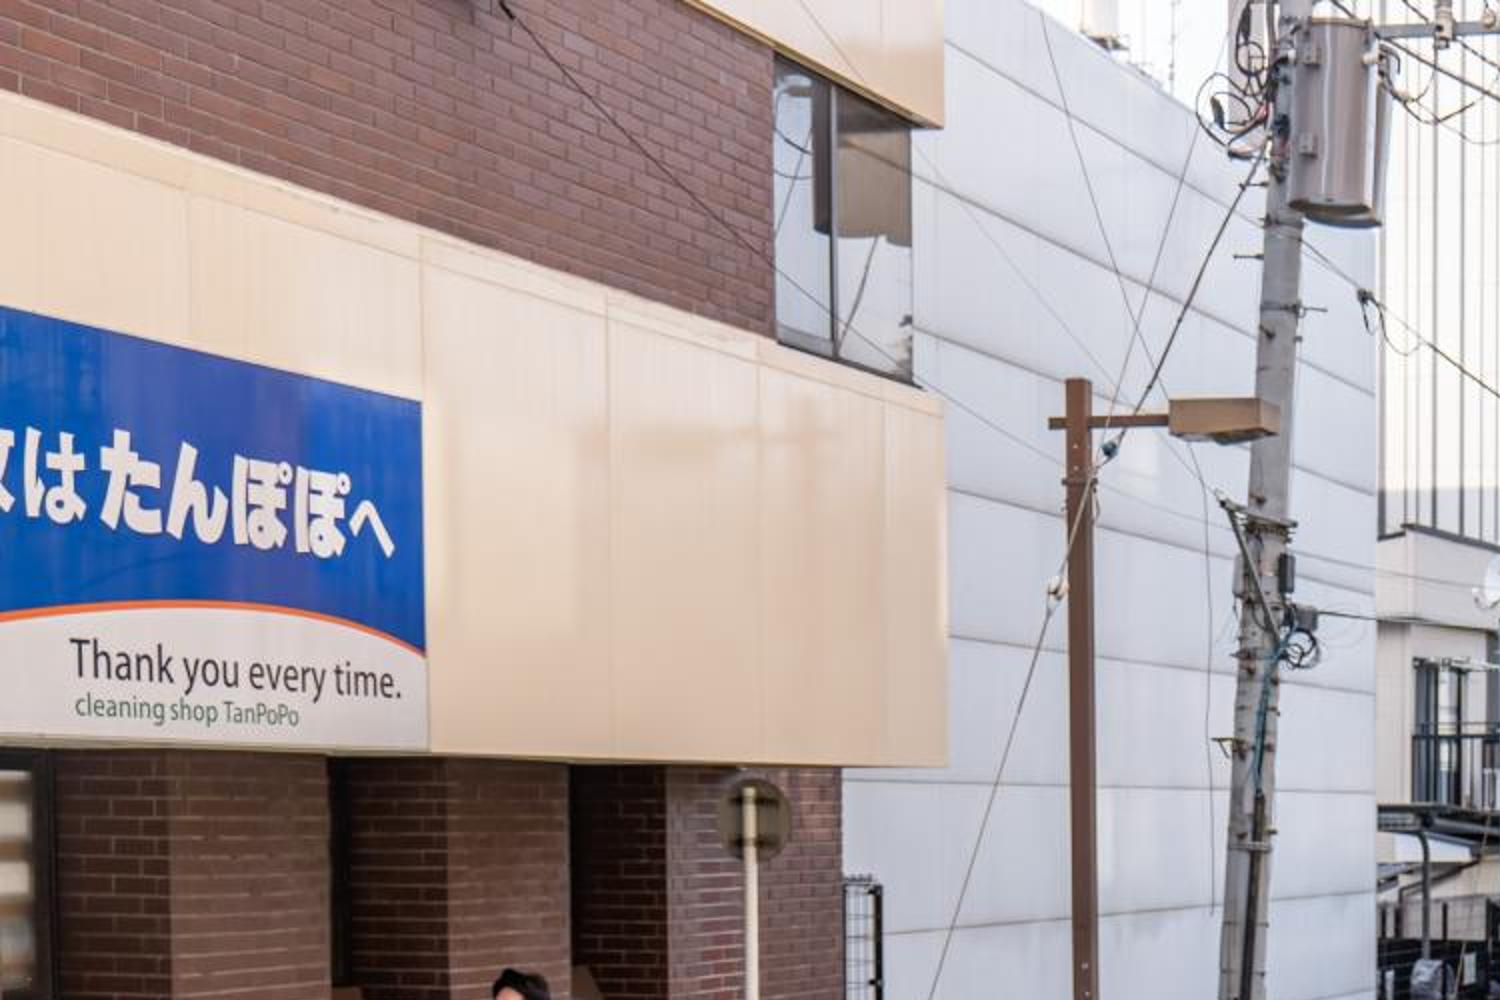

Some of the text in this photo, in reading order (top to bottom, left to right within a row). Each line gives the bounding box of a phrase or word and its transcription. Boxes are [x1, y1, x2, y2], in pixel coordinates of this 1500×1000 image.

[70, 638, 401, 703] Thank you every time.
[75, 693, 300, 727] cleaning shop TanPoPo
